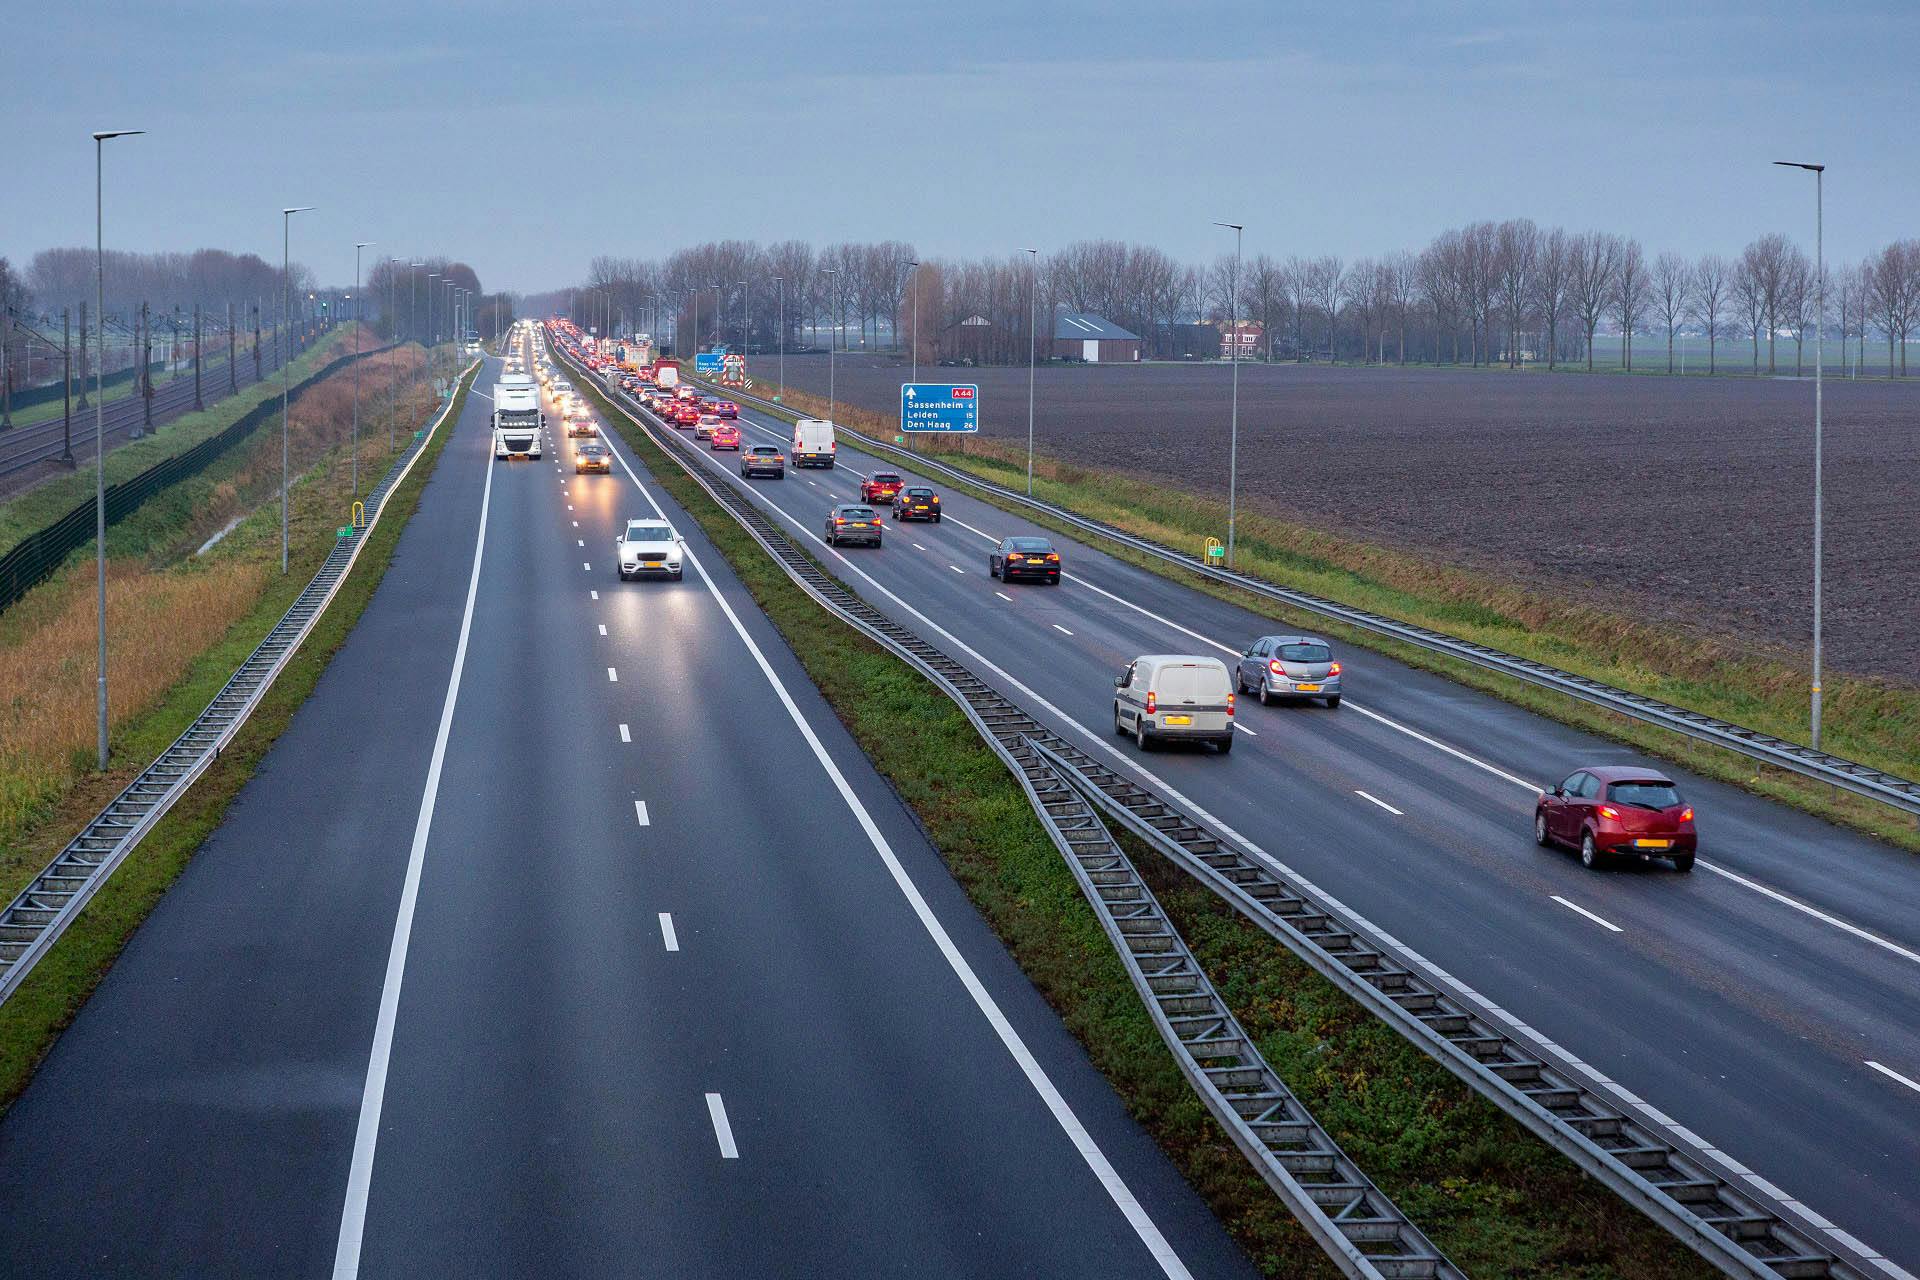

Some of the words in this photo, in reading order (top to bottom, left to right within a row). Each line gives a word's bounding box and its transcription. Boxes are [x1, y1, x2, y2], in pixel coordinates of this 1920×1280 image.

[908, 401, 963, 409] Sassenheim
[907, 411, 938, 419] Leiden
[927, 421, 951, 430] Haag
